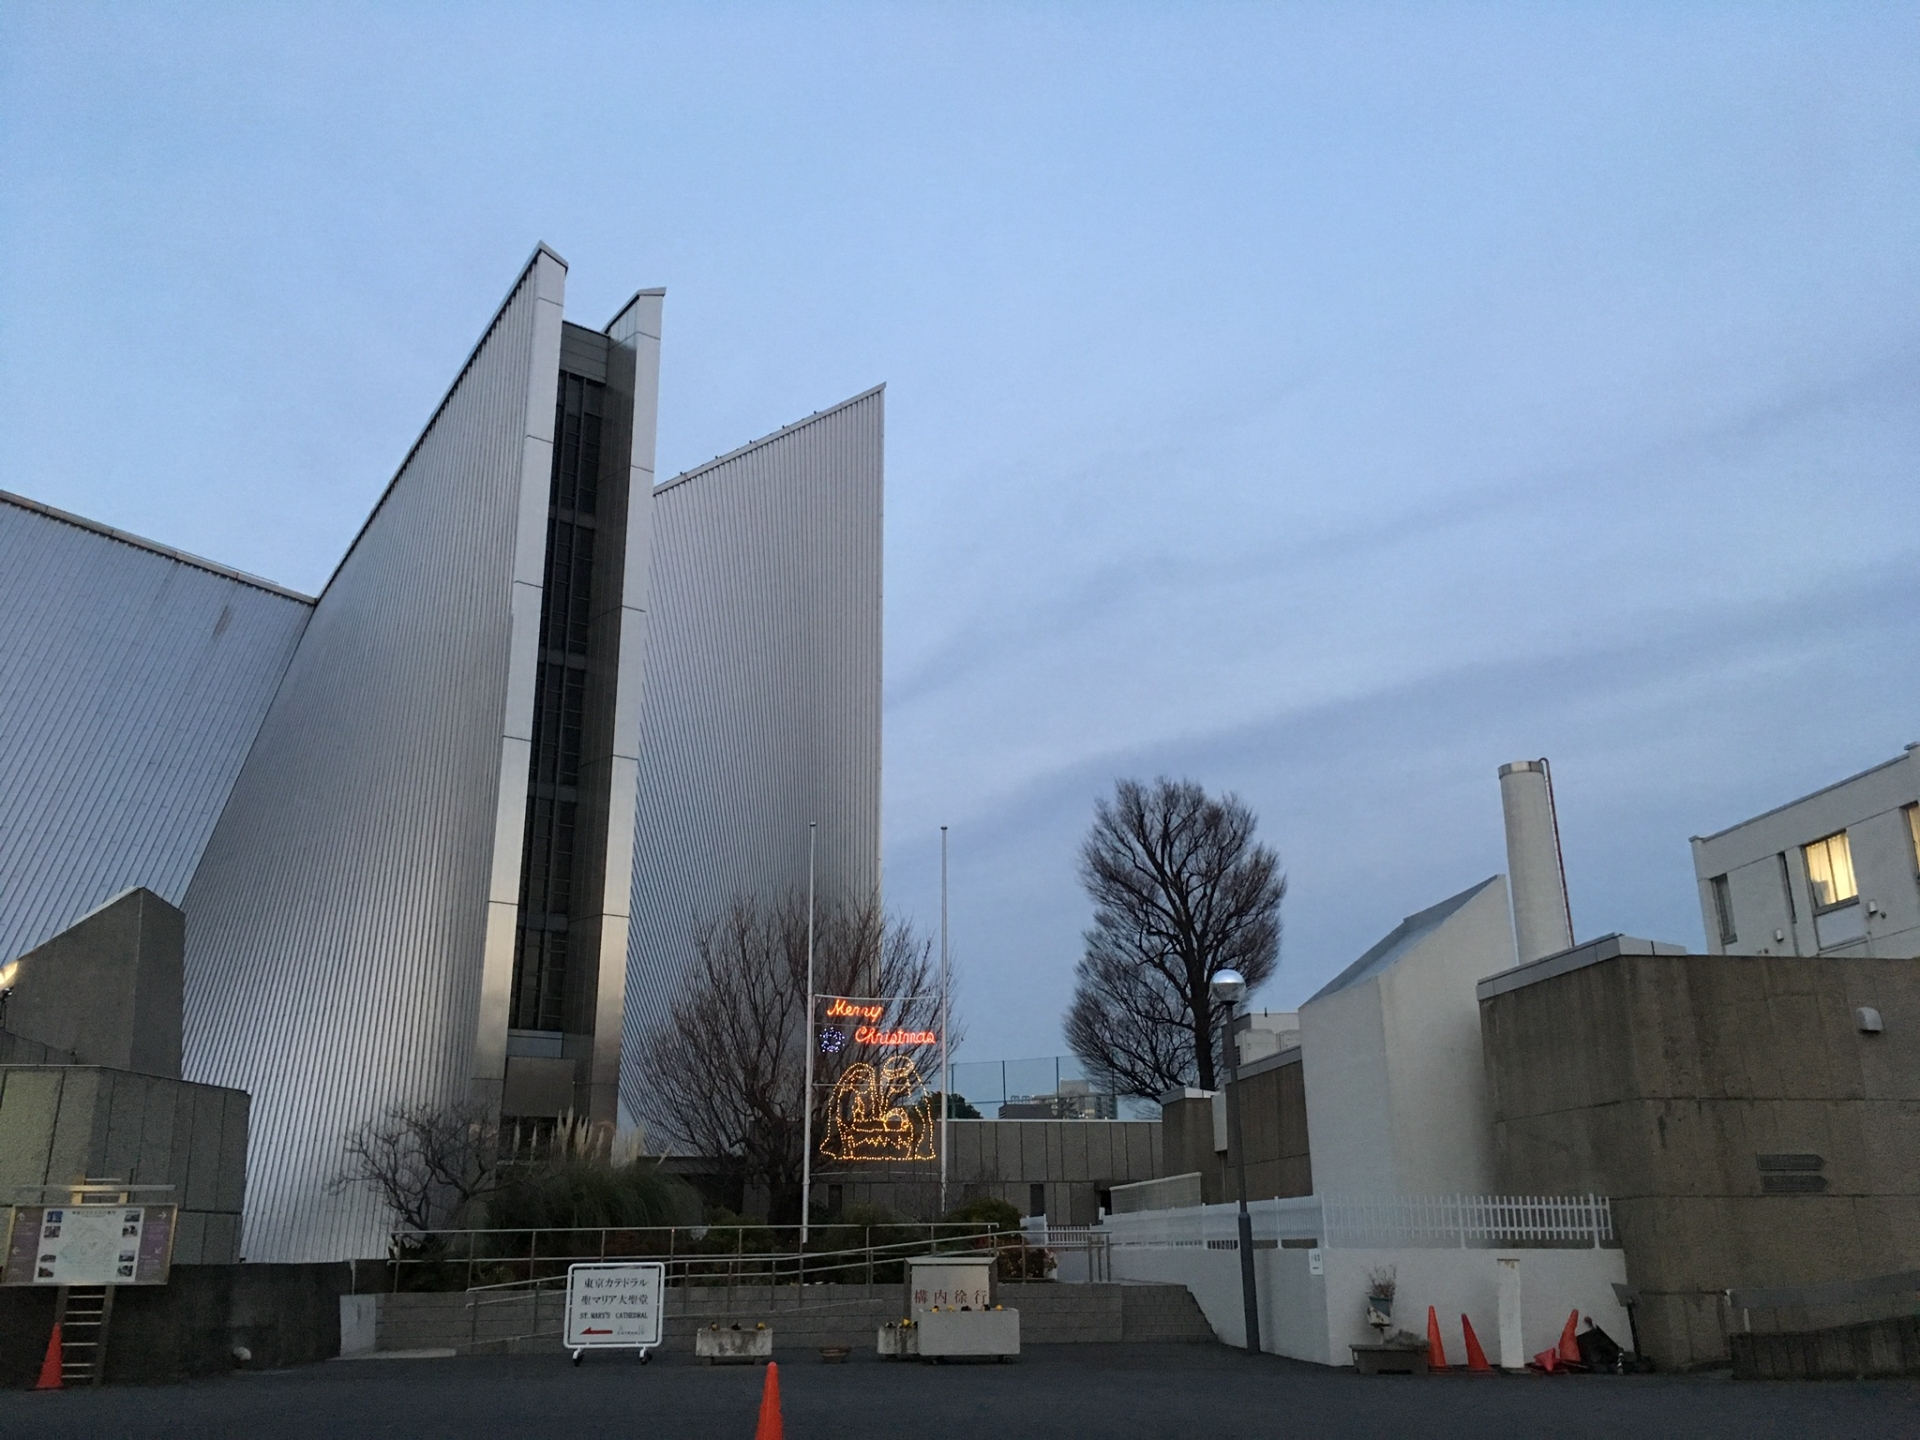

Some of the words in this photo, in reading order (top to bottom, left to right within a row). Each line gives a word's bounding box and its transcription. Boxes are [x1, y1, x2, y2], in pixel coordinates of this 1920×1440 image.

[827, 998, 883, 1022] Merry
[855, 1026, 936, 1044] Christmas
[584, 1278, 648, 1288] 東京カテドラル
[581, 1295, 648, 1305] 聖マリア大聖堂
[914, 1289, 987, 1304] 構内徐行
